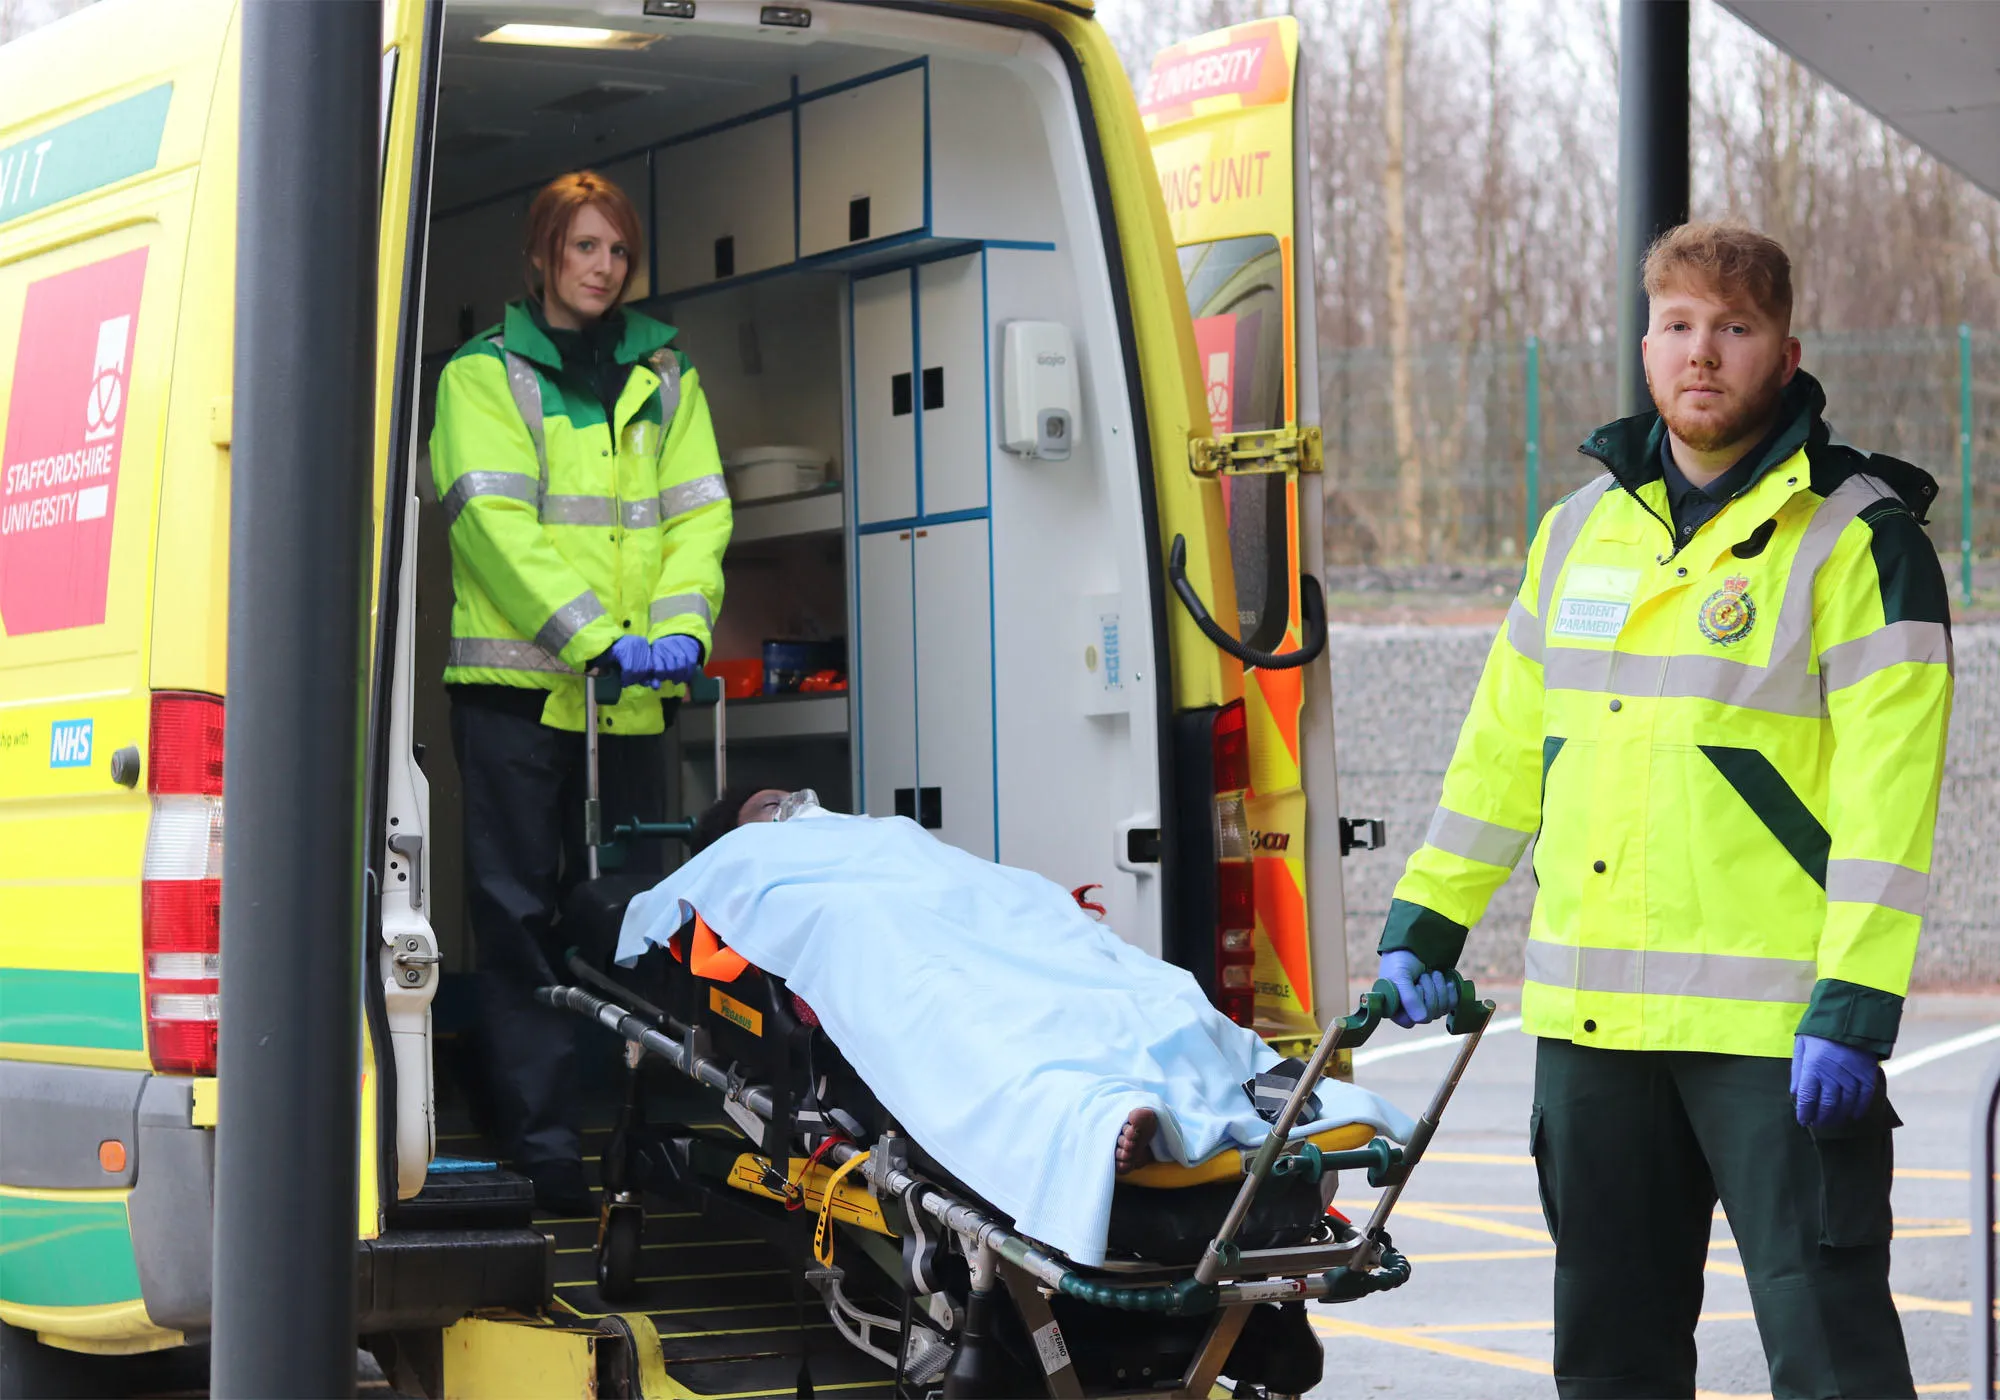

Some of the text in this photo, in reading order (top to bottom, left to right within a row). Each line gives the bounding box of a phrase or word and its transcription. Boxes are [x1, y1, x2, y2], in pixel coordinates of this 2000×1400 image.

[1156, 46, 1262, 102] UNIVERSITY
[1210, 150, 1271, 204] UNIT
[5, 443, 114, 496] STAFFORDSHIRE
[1, 491, 77, 535] UNIVERSITY
[1559, 617, 1620, 634] PARAMEDIC
[1569, 603, 1617, 617] STUDENT
[51, 723, 92, 762] NHS
[1053, 1333, 1067, 1357] FERNO
